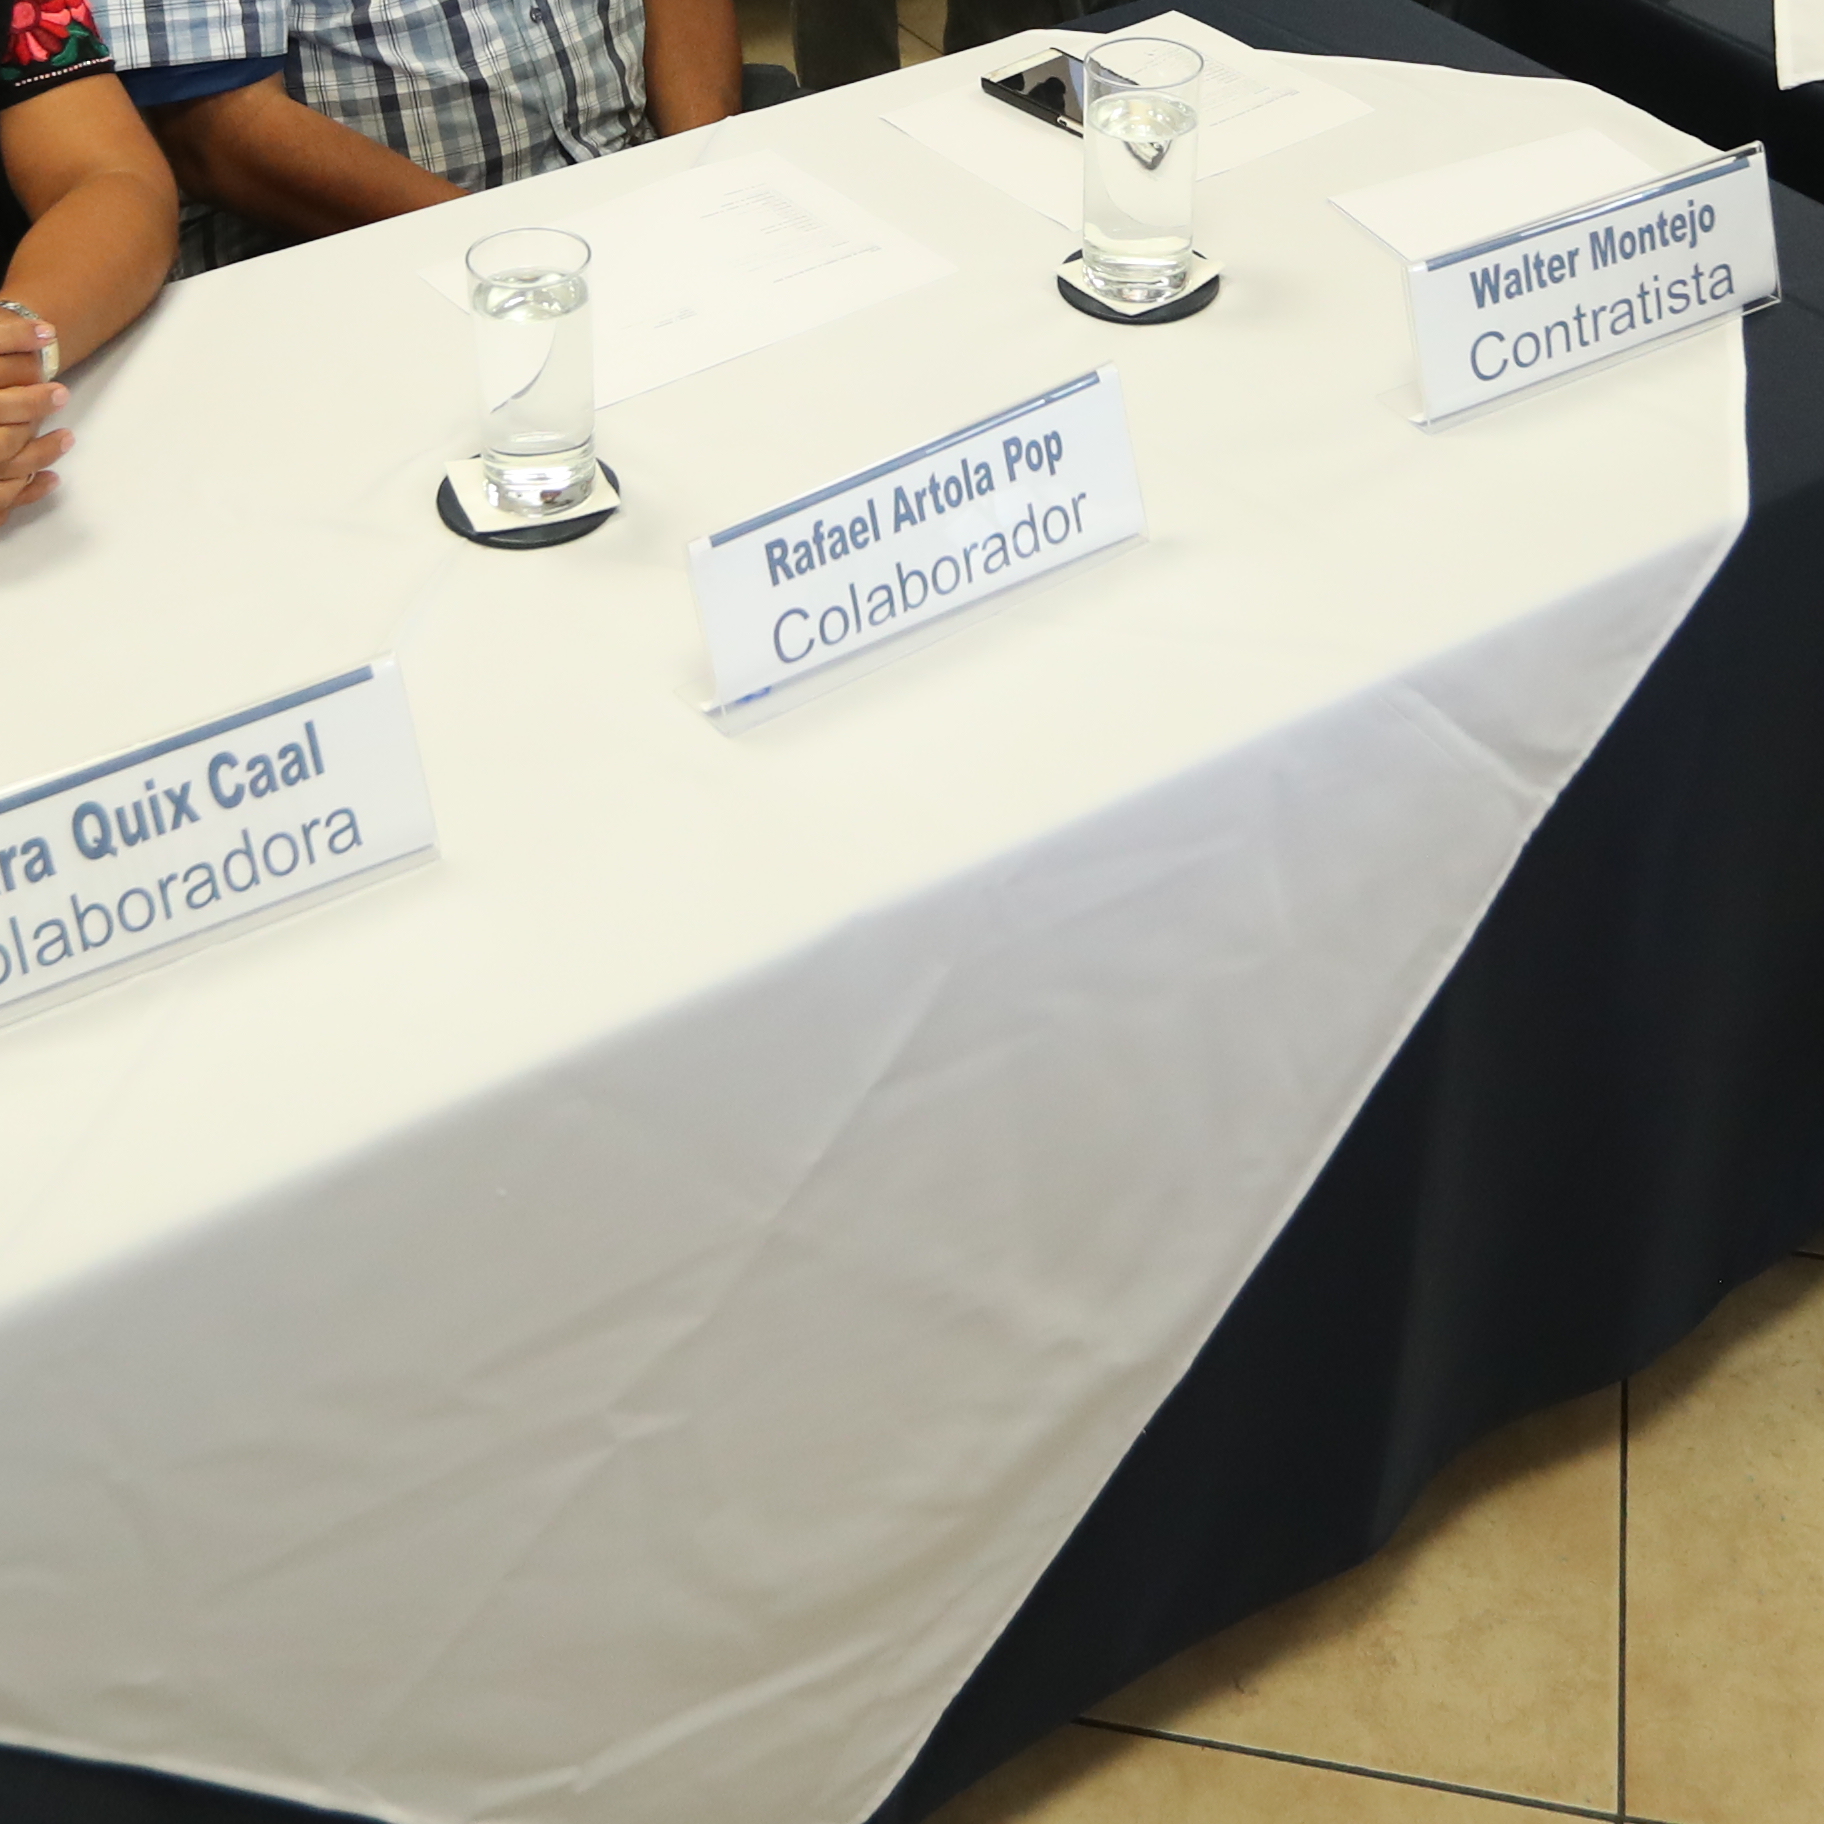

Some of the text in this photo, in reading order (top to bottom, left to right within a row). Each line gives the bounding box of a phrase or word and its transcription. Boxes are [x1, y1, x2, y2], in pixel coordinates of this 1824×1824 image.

[1469, 199, 1715, 309] Walter Montejo
[1469, 262, 1735, 382] Contratista
[764, 429, 1064, 588] Rafael Artola Pop
[772, 491, 1088, 665] Colaborador
[71, 778, 200, 861] Quix
[207, 720, 325, 810] Caal
